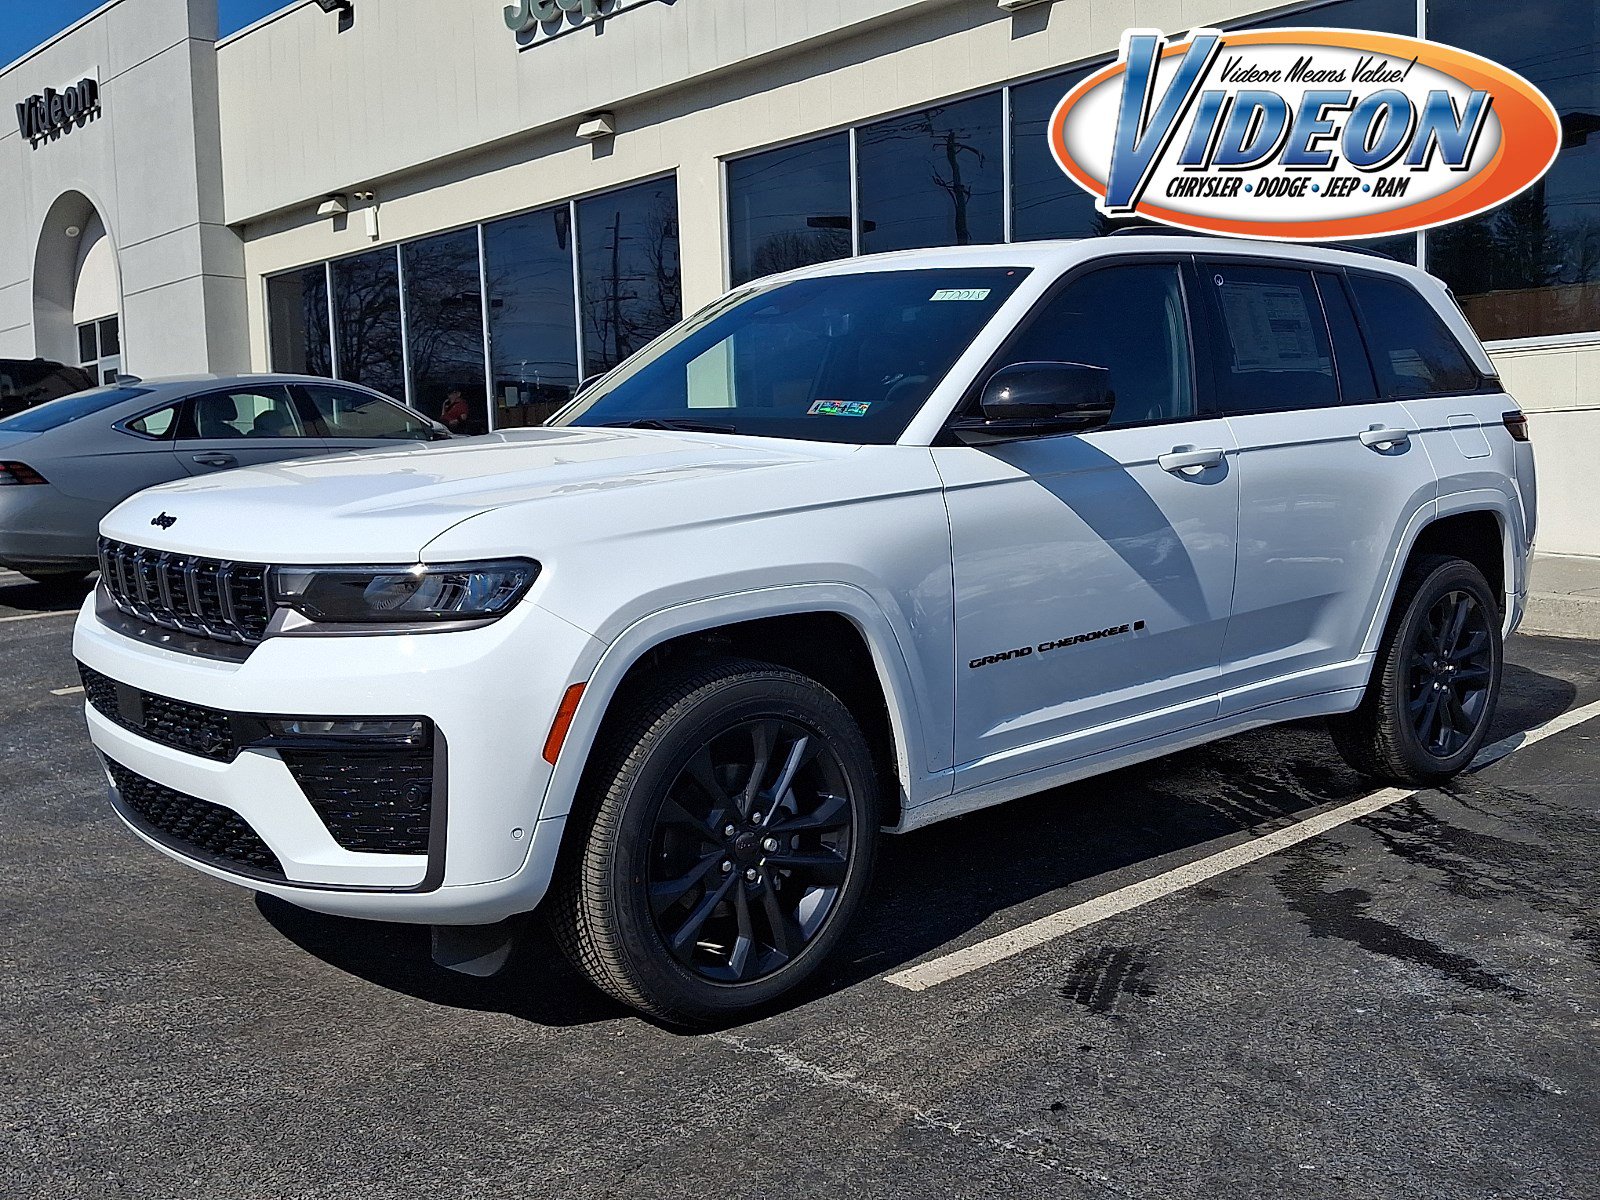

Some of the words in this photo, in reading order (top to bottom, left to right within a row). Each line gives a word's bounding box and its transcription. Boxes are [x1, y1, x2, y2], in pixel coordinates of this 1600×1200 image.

[15, 78, 98, 139] Videon
[968, 646, 1033, 669] GRAND
[1037, 624, 1130, 653] CHEROKEE
